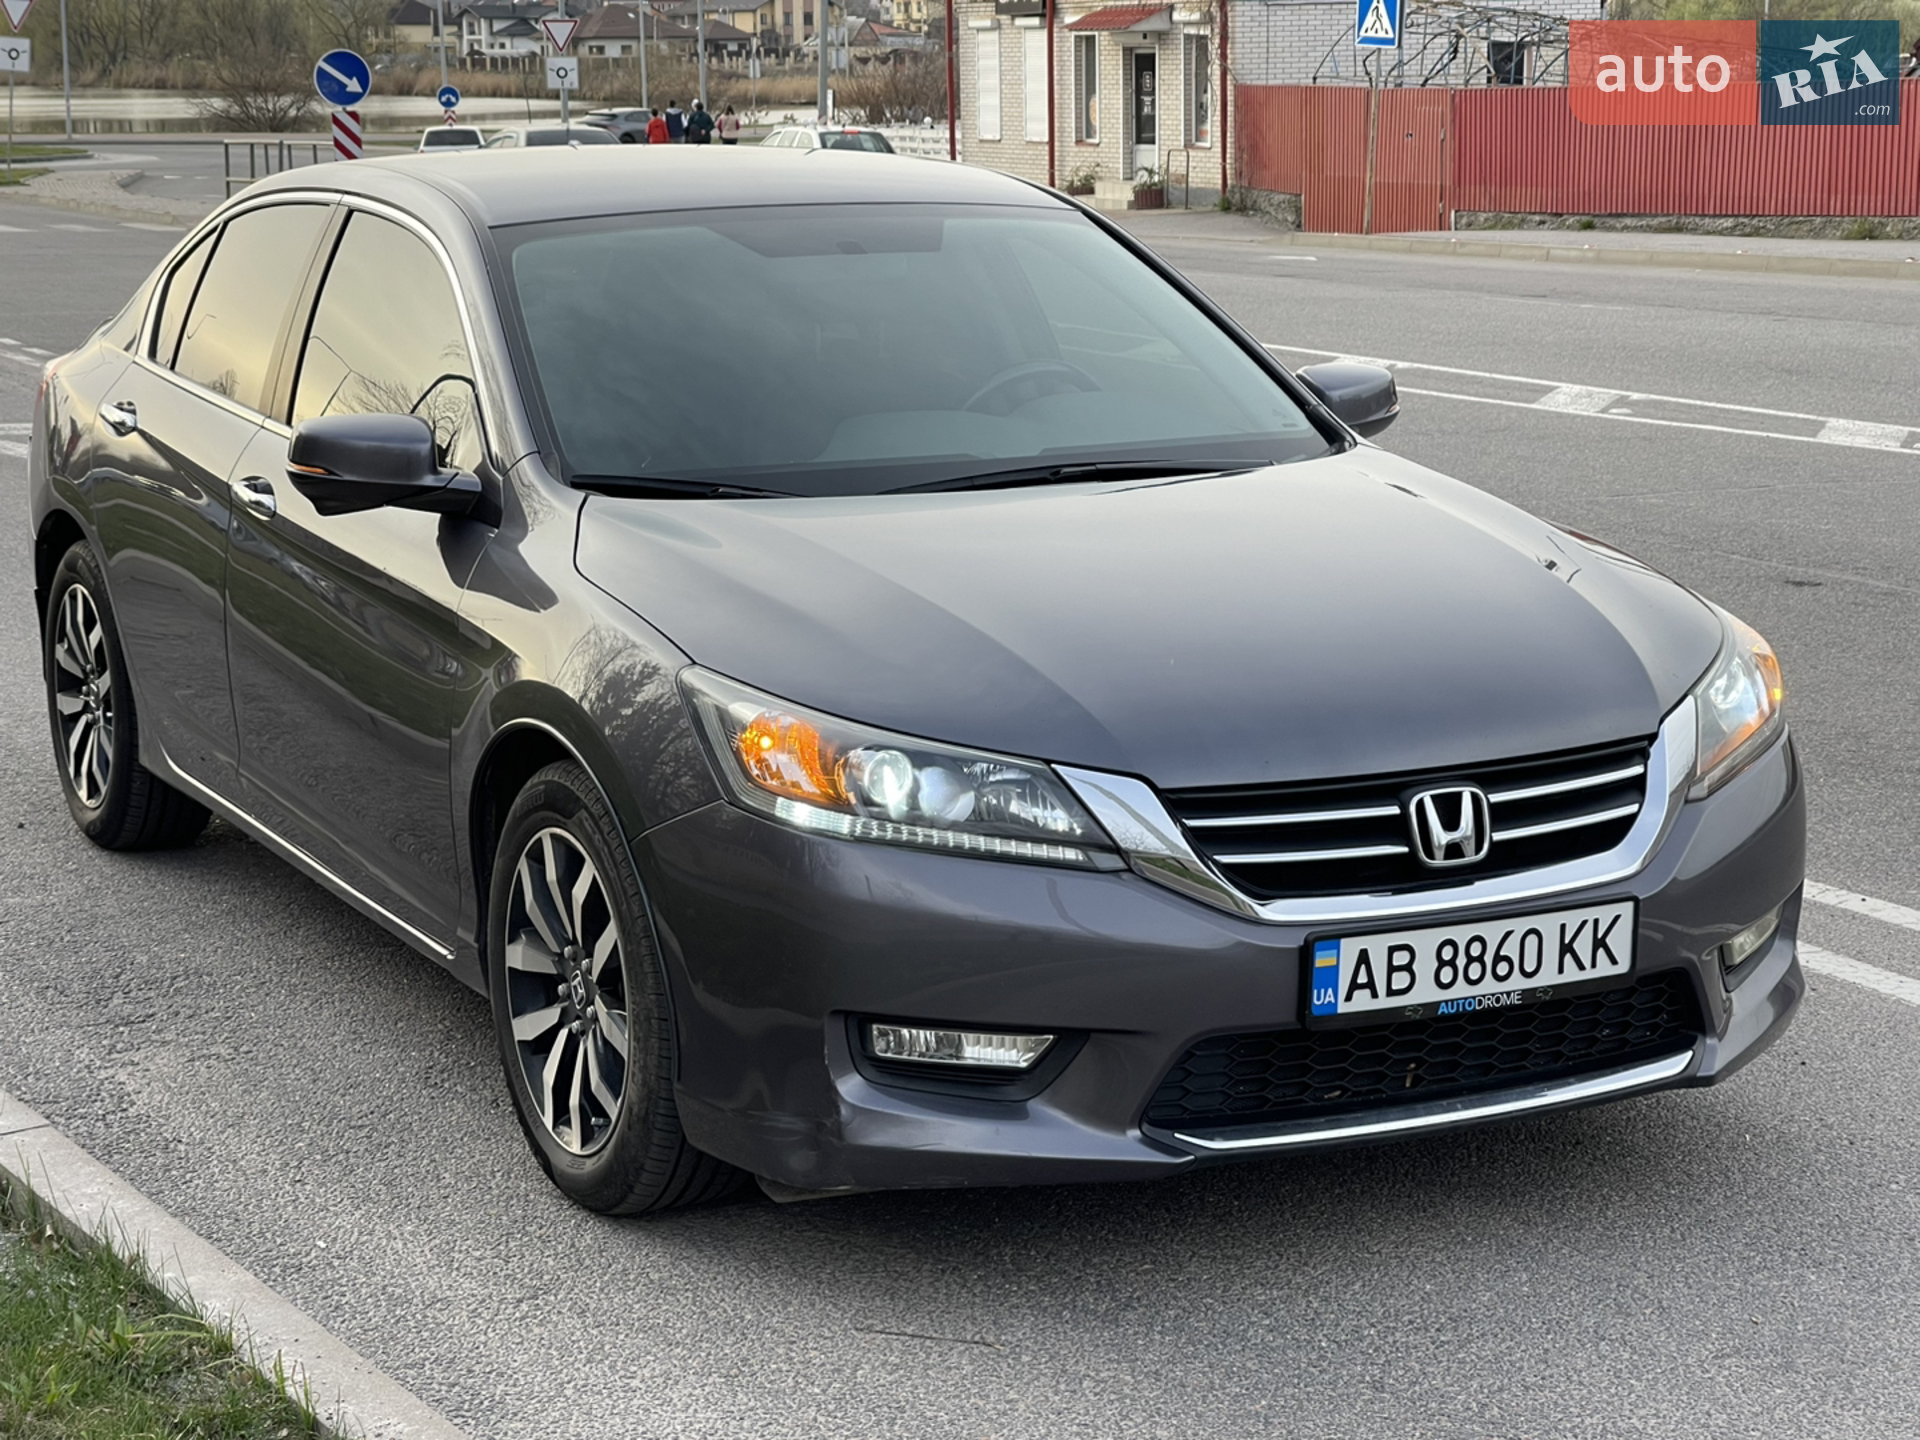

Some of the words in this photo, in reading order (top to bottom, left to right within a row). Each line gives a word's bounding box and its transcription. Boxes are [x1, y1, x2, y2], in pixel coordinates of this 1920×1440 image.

[1344, 943, 1416, 1002] AB
[1434, 927, 1543, 990] 8860
[1557, 913, 1622, 975] KK
[1313, 987, 1336, 1005] UA
[1438, 990, 1523, 1015] AUTODROME
